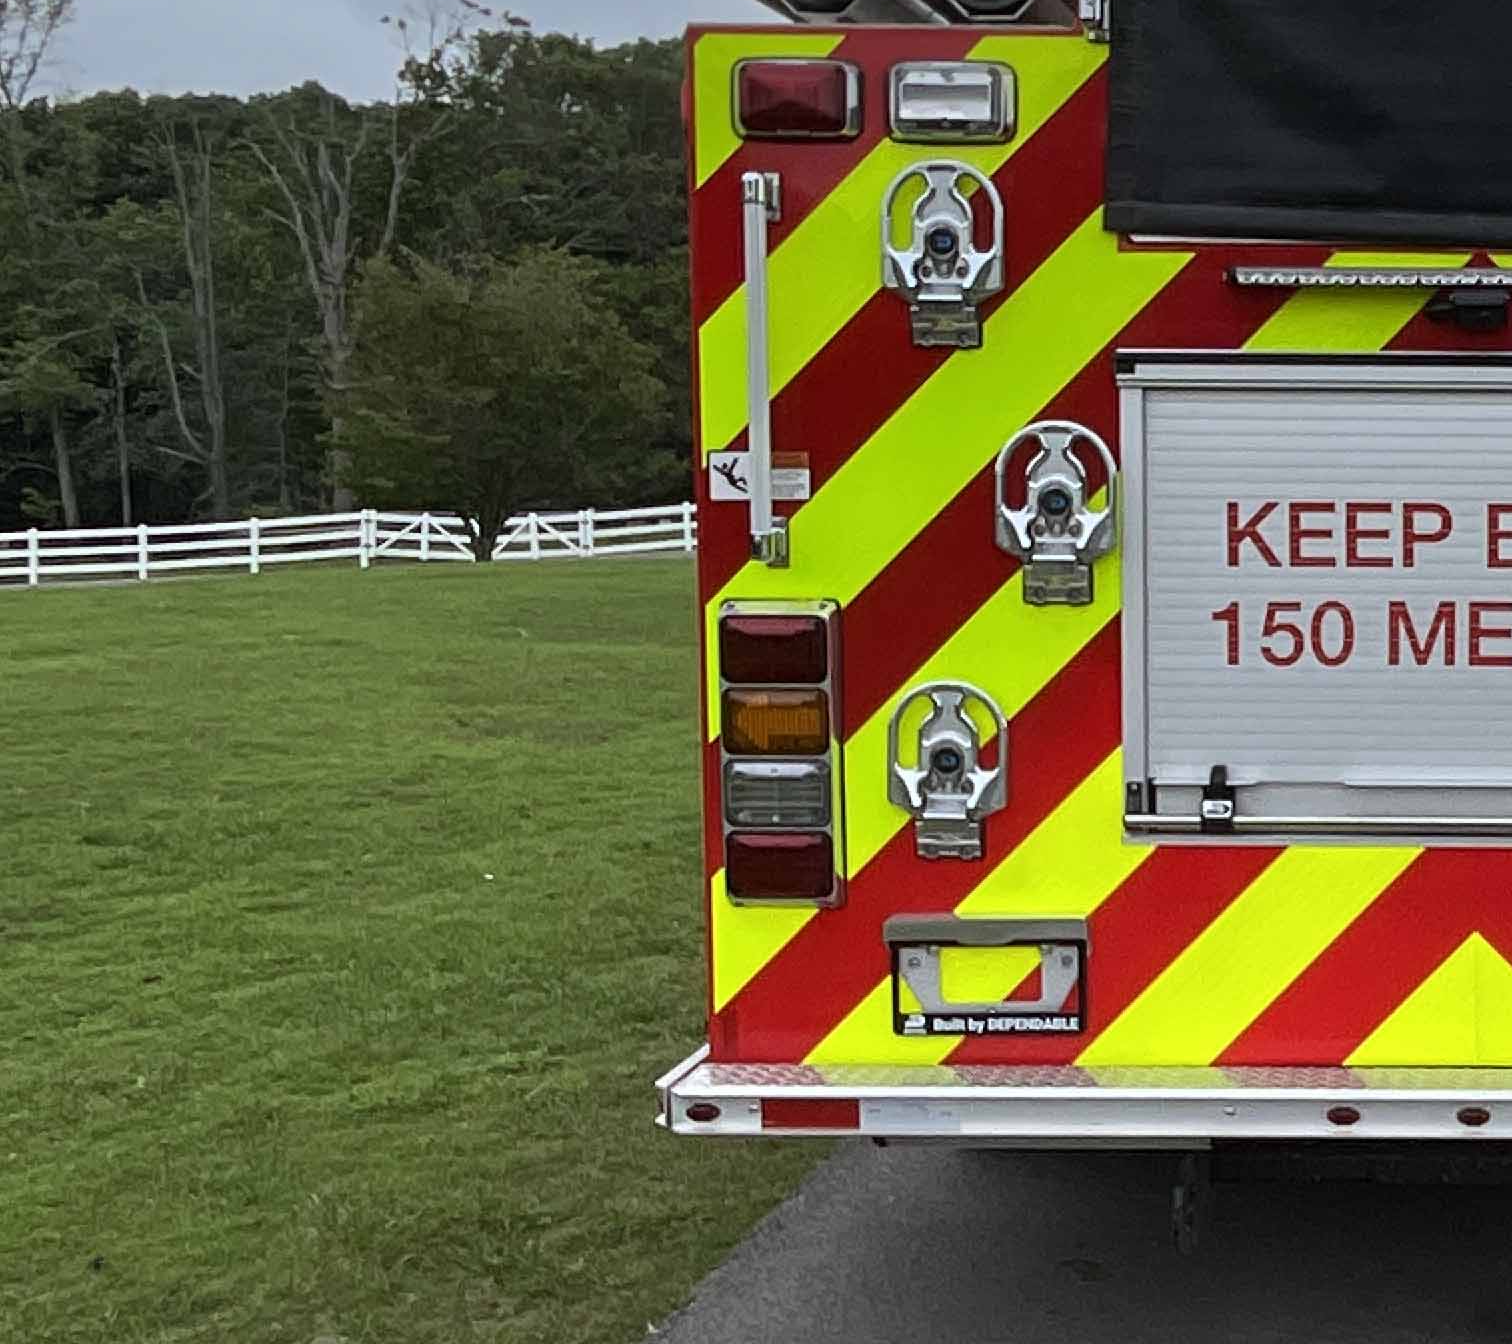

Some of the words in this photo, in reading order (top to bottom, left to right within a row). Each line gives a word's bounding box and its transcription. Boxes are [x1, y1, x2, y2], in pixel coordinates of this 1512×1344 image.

[1227, 500, 1453, 568] KEEP
[1211, 600, 1356, 667] 150
[968, 1017, 986, 1034] by
[987, 1016, 1080, 1032] DEPENDABLE
